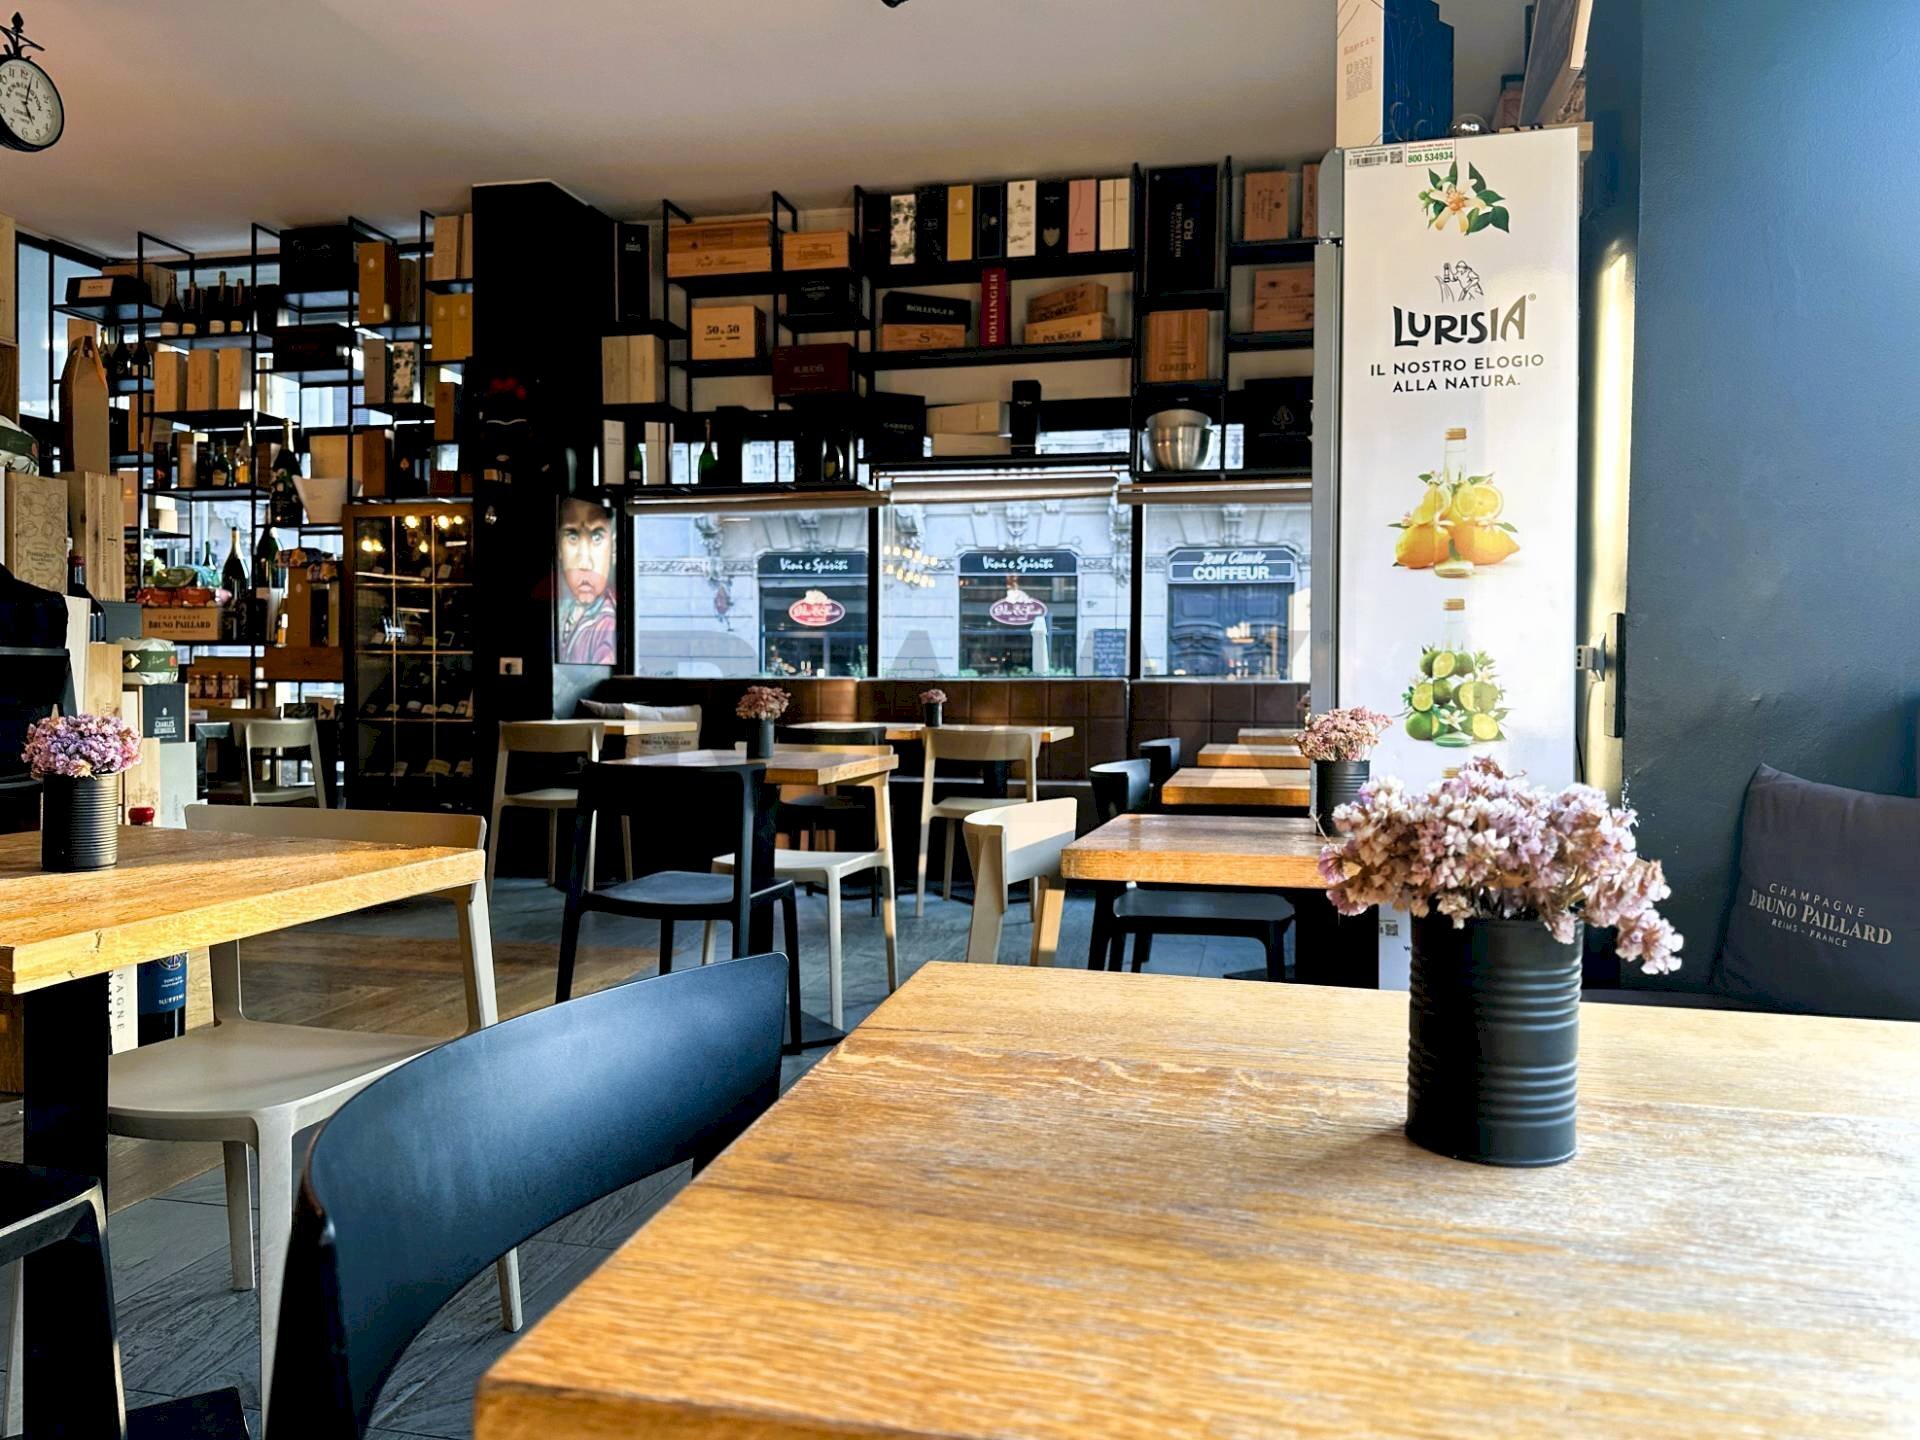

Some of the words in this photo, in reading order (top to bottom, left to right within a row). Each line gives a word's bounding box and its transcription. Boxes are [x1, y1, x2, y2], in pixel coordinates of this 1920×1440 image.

[1408, 153, 1422, 164] 800
[1425, 151, 1454, 162] 534934
[987, 273, 998, 343] BOLLINGER
[1392, 294, 1528, 347] LURISIA
[1371, 363, 1386, 377] IL
[1394, 358, 1467, 375] NOSTRO
[1474, 353, 1545, 371] ELOGIO
[1392, 377, 1436, 393] ALLA
[1445, 374, 1521, 391] NATURA.
[779, 558, 803, 572] Vini
[812, 558, 849, 574] Spiriti
[982, 555, 1007, 570] Vini
[1016, 555, 1054, 574] Spiriti
[1192, 566, 1270, 581] COIFFEUR
[1768, 883, 1867, 919] CHAMPAGNE
[1748, 888, 1798, 919] BRUNO
[1800, 903, 1893, 946] PAILLARD
[1770, 917, 1799, 934] REIMS
[1808, 928, 1849, 949] FRANCE
